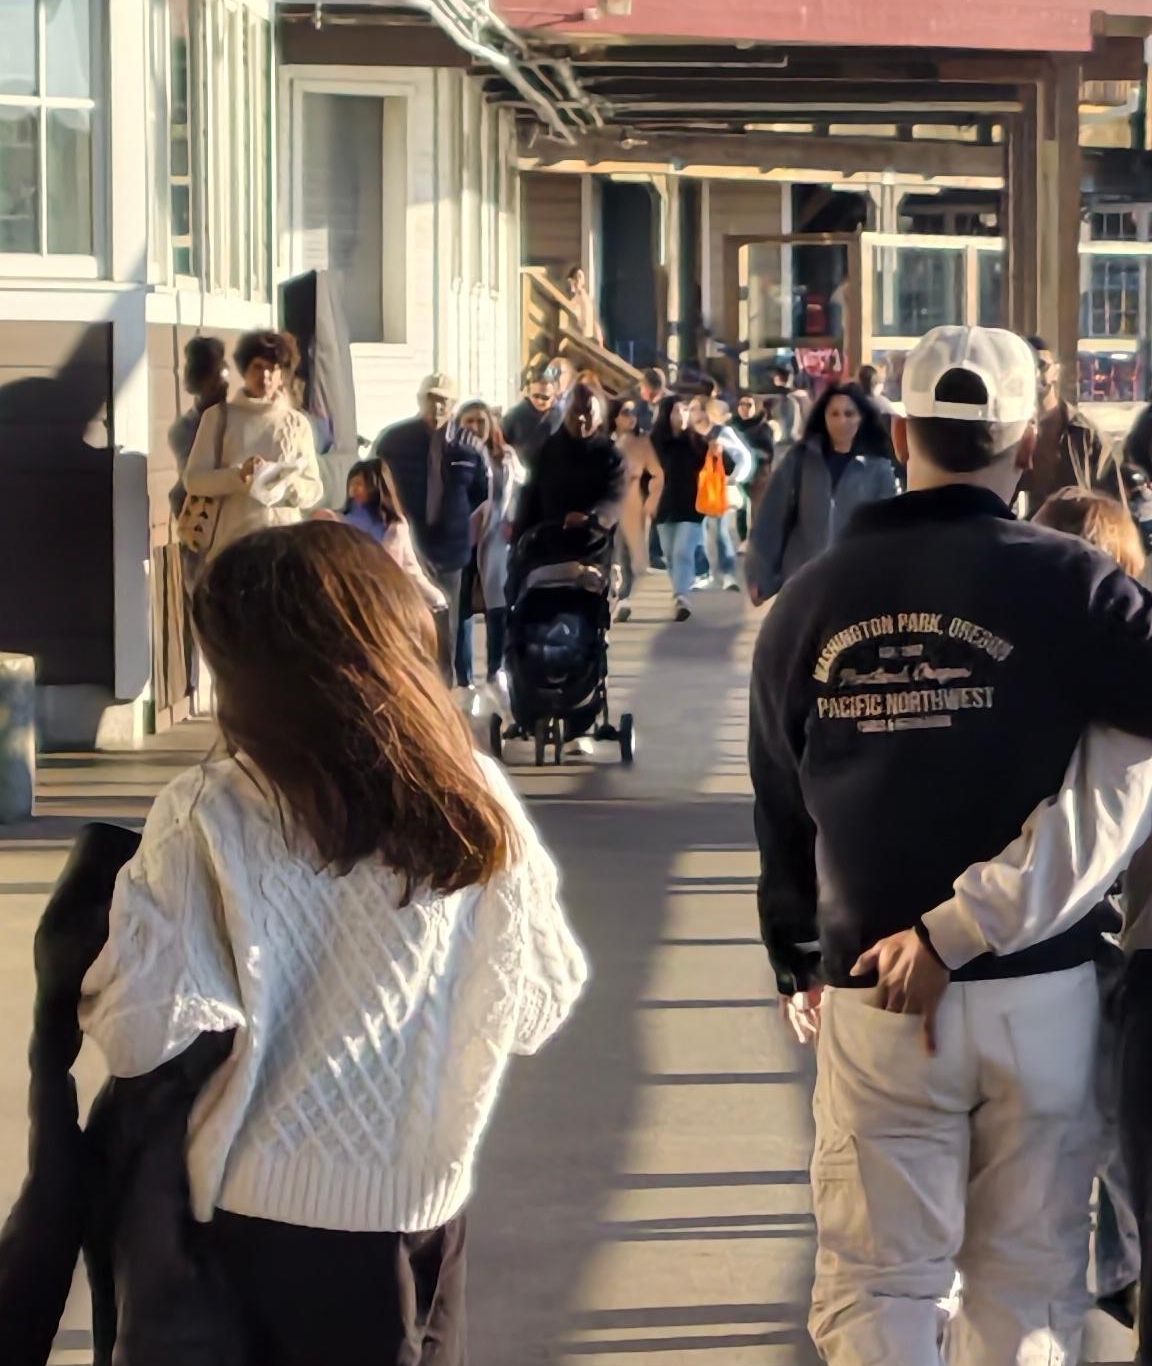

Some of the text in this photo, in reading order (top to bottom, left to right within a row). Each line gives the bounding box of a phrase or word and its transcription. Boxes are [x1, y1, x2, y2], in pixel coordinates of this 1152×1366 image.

[813, 614, 894, 683] WASHINGTON
[897, 612, 944, 636] PARK,
[948, 616, 1015, 662] OREGON
[817, 686, 995, 719] PACIFIC NORTHWEST
